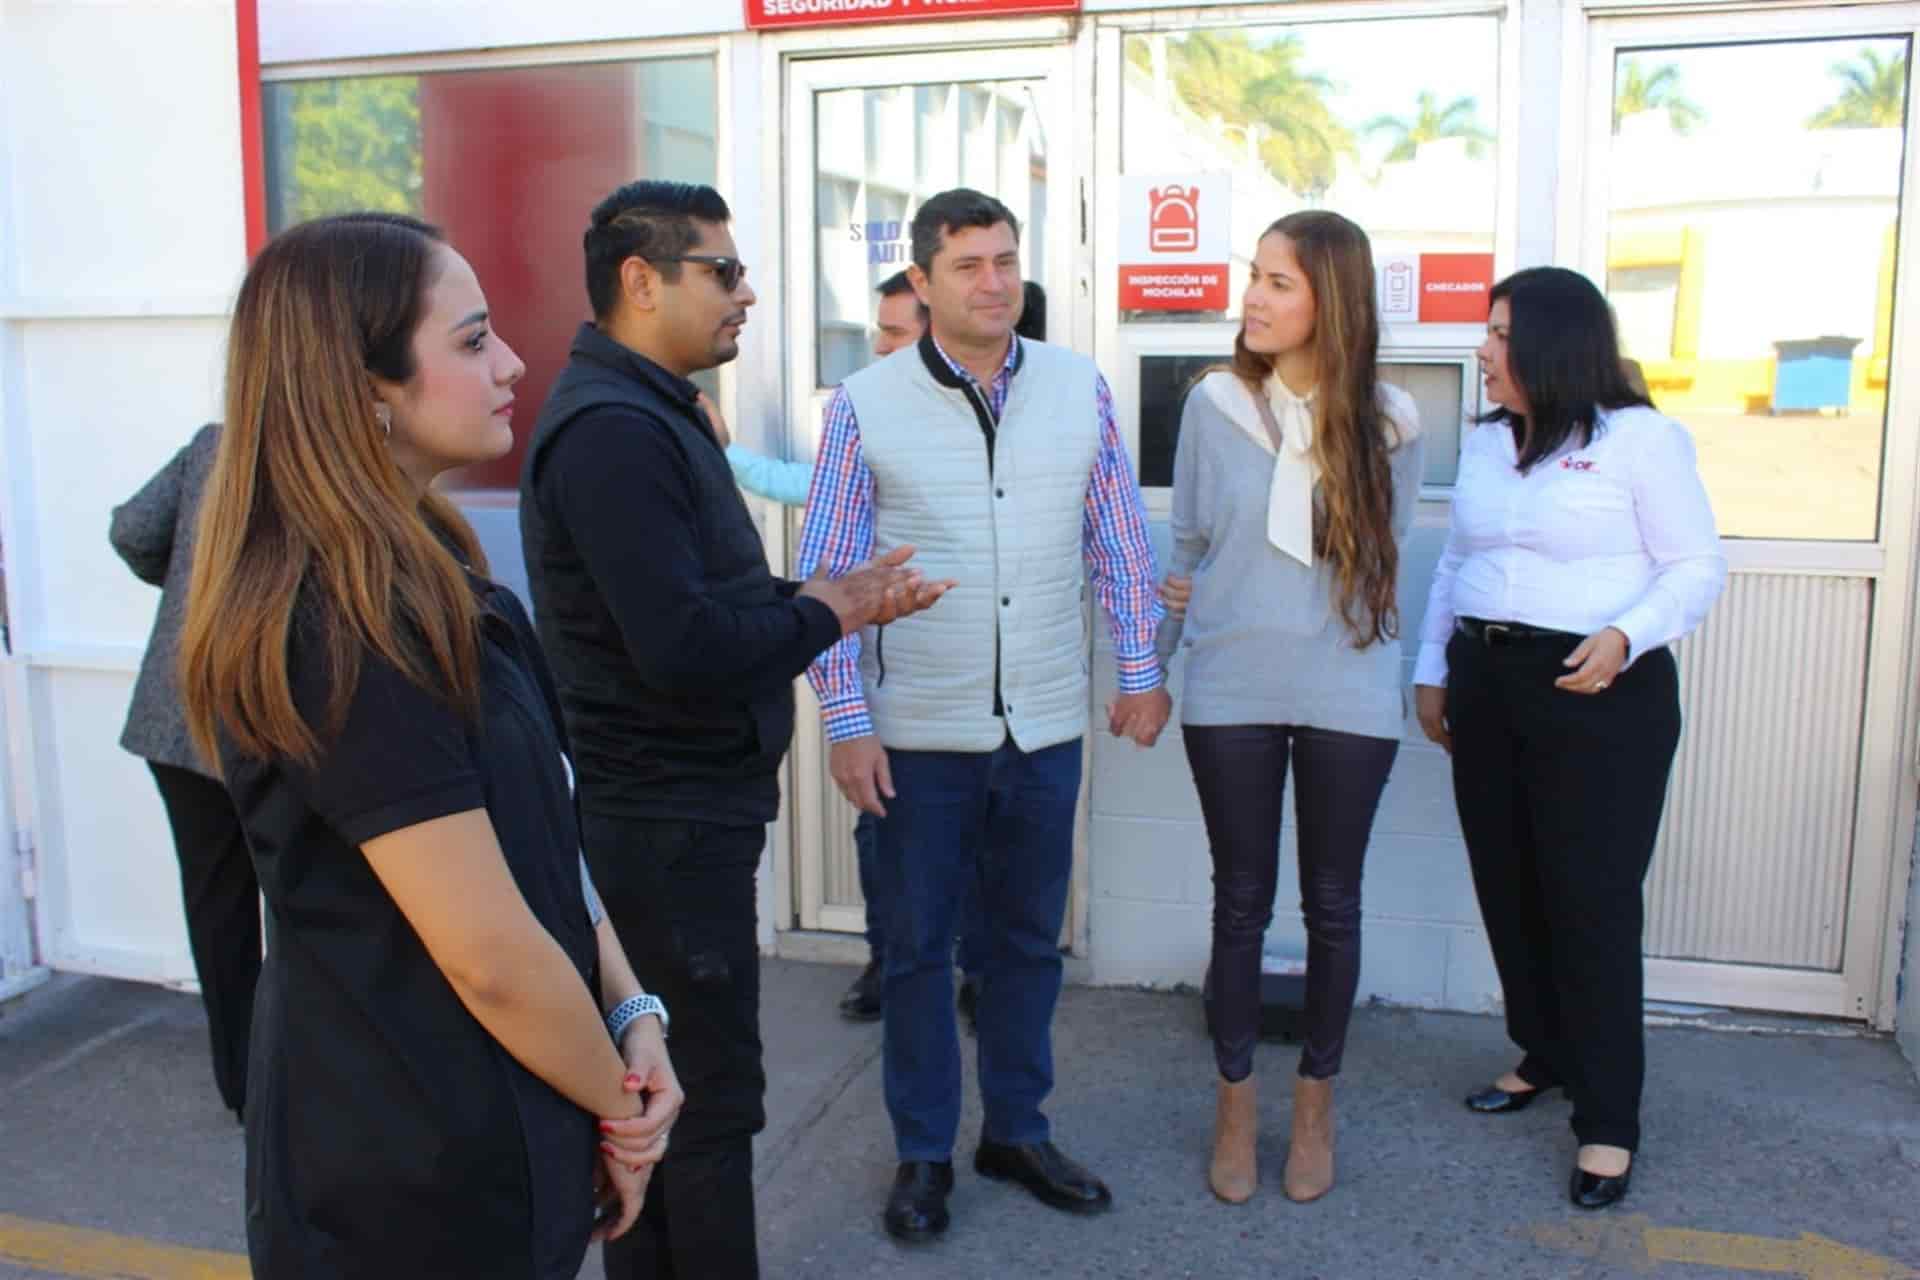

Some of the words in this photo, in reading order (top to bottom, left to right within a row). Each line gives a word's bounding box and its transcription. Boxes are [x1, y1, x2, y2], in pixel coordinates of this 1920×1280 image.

[1127, 274, 1200, 286] INSPECCIÓN
[1201, 275, 1217, 286] DE
[1141, 287, 1204, 298] MOCHILAS
[1425, 281, 1486, 293] CHECADOR
